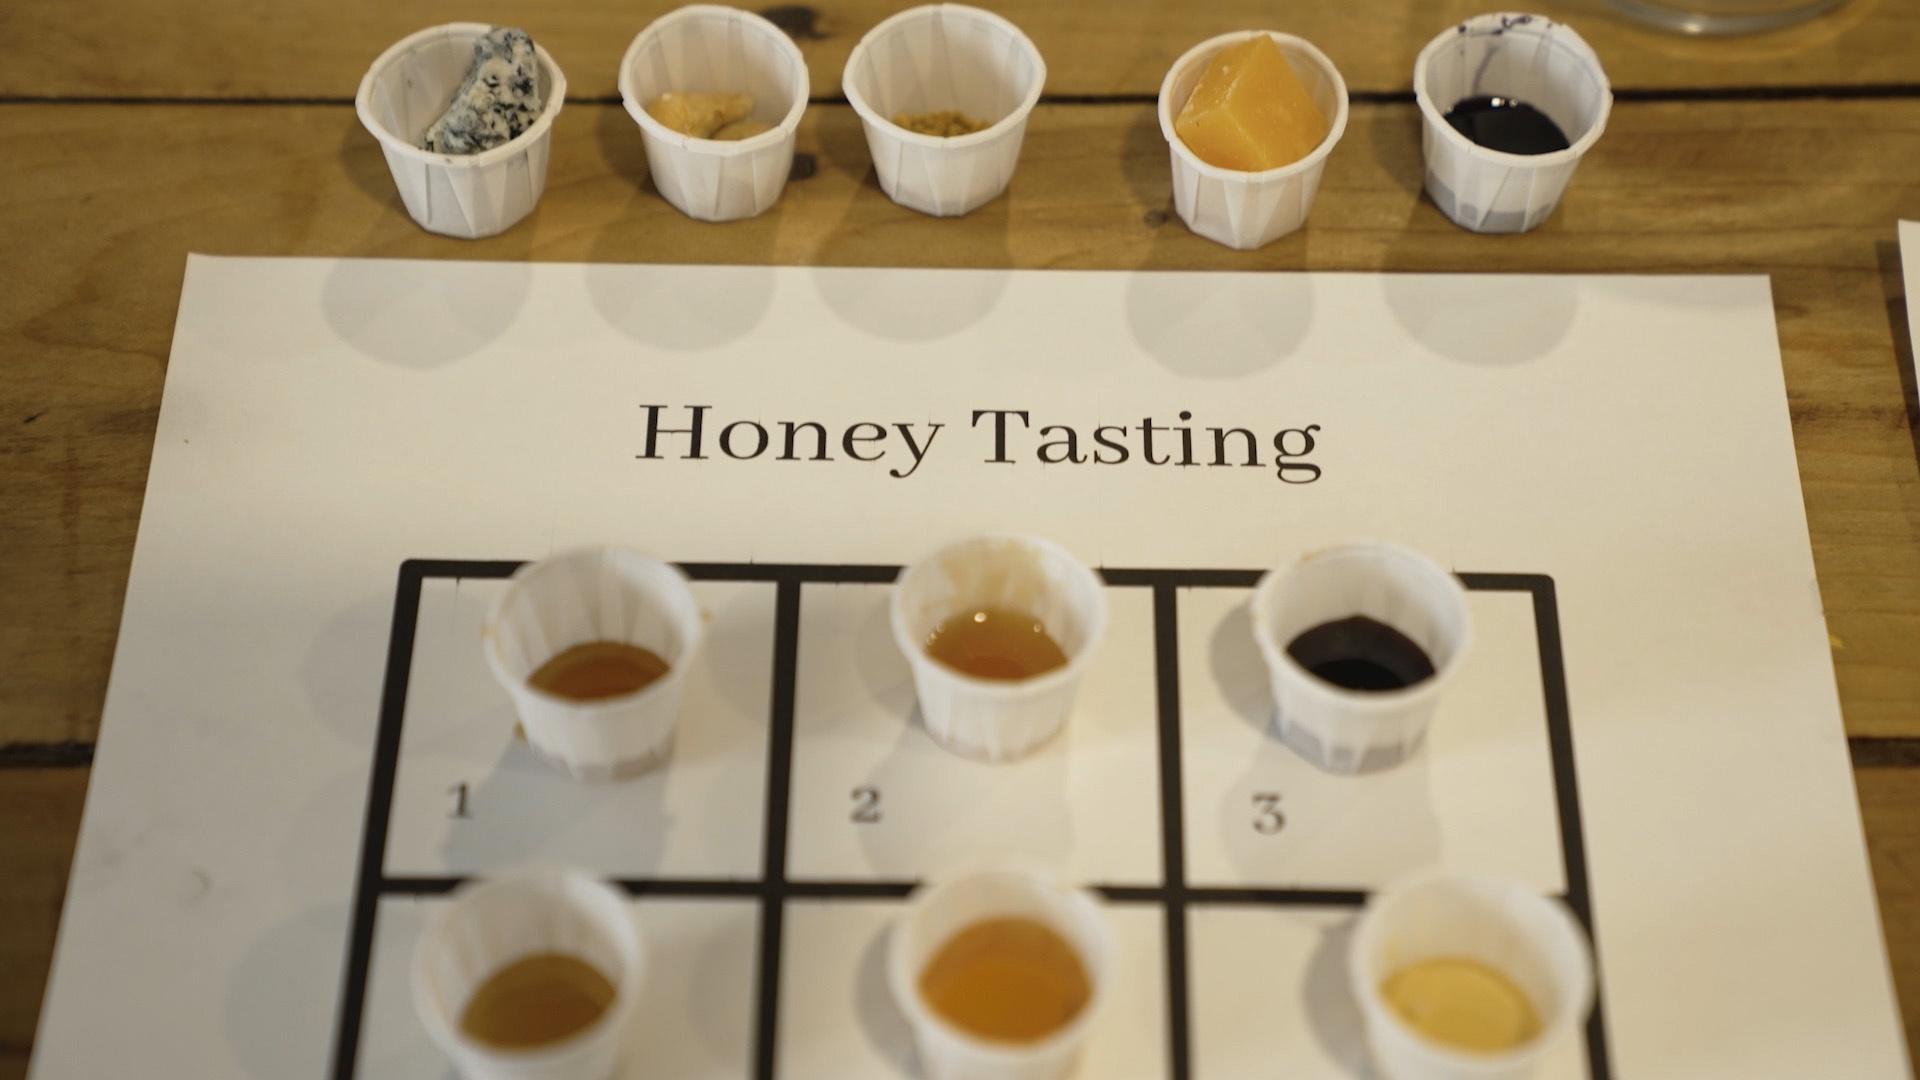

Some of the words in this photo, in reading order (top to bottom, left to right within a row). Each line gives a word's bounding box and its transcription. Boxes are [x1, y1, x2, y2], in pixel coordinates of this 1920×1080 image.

[635, 404, 945, 479] Honey
[971, 409, 1322, 485] Tasting
[447, 783, 473, 819] 1
[850, 787, 882, 823] 2
[1251, 792, 1287, 835] 3
